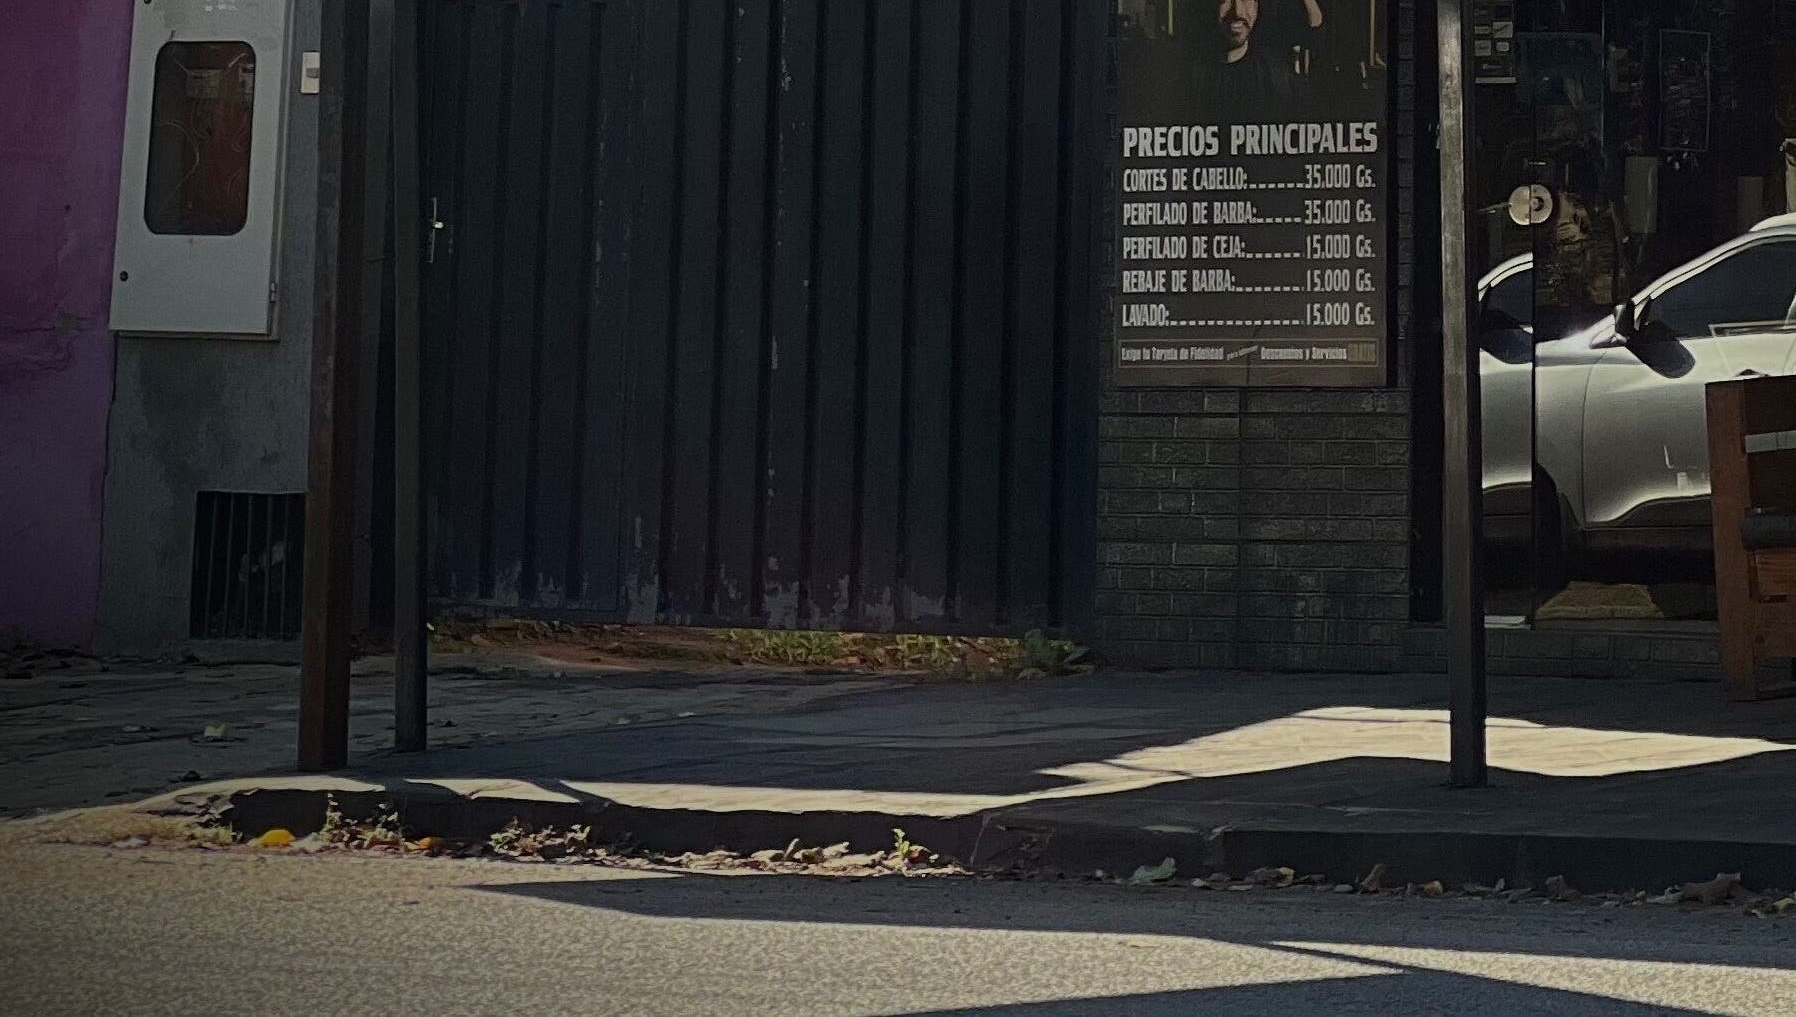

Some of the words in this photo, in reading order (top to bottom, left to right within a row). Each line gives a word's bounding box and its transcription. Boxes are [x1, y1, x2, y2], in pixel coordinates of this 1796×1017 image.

[1123, 126, 1219, 157] PRECIOS
[1230, 122, 1378, 155] PRINCIPALES
[1123, 168, 1168, 191] CORTES
[1172, 168, 1188, 190] DE
[1304, 164, 1351, 188] 35.000
[1356, 164, 1376, 188] Gs.
[1123, 202, 1188, 225] PERFILADO
[1192, 202, 1208, 224] DE
[1304, 199, 1351, 224] 35.000
[1356, 199, 1376, 222] Gs.
[1123, 236, 1187, 259] PERFILADO
[1192, 236, 1208, 258] DE
[1306, 234, 1350, 259] 15.000
[1355, 235, 1376, 258] Gs.
[1122, 270, 1167, 293] REBAJE
[1171, 270, 1187, 292] DE
[1306, 269, 1350, 292] 15.000
[1355, 268, 1375, 292] Gs.
[1306, 302, 1350, 326] 15.000
[1355, 302, 1375, 325] Gs.
